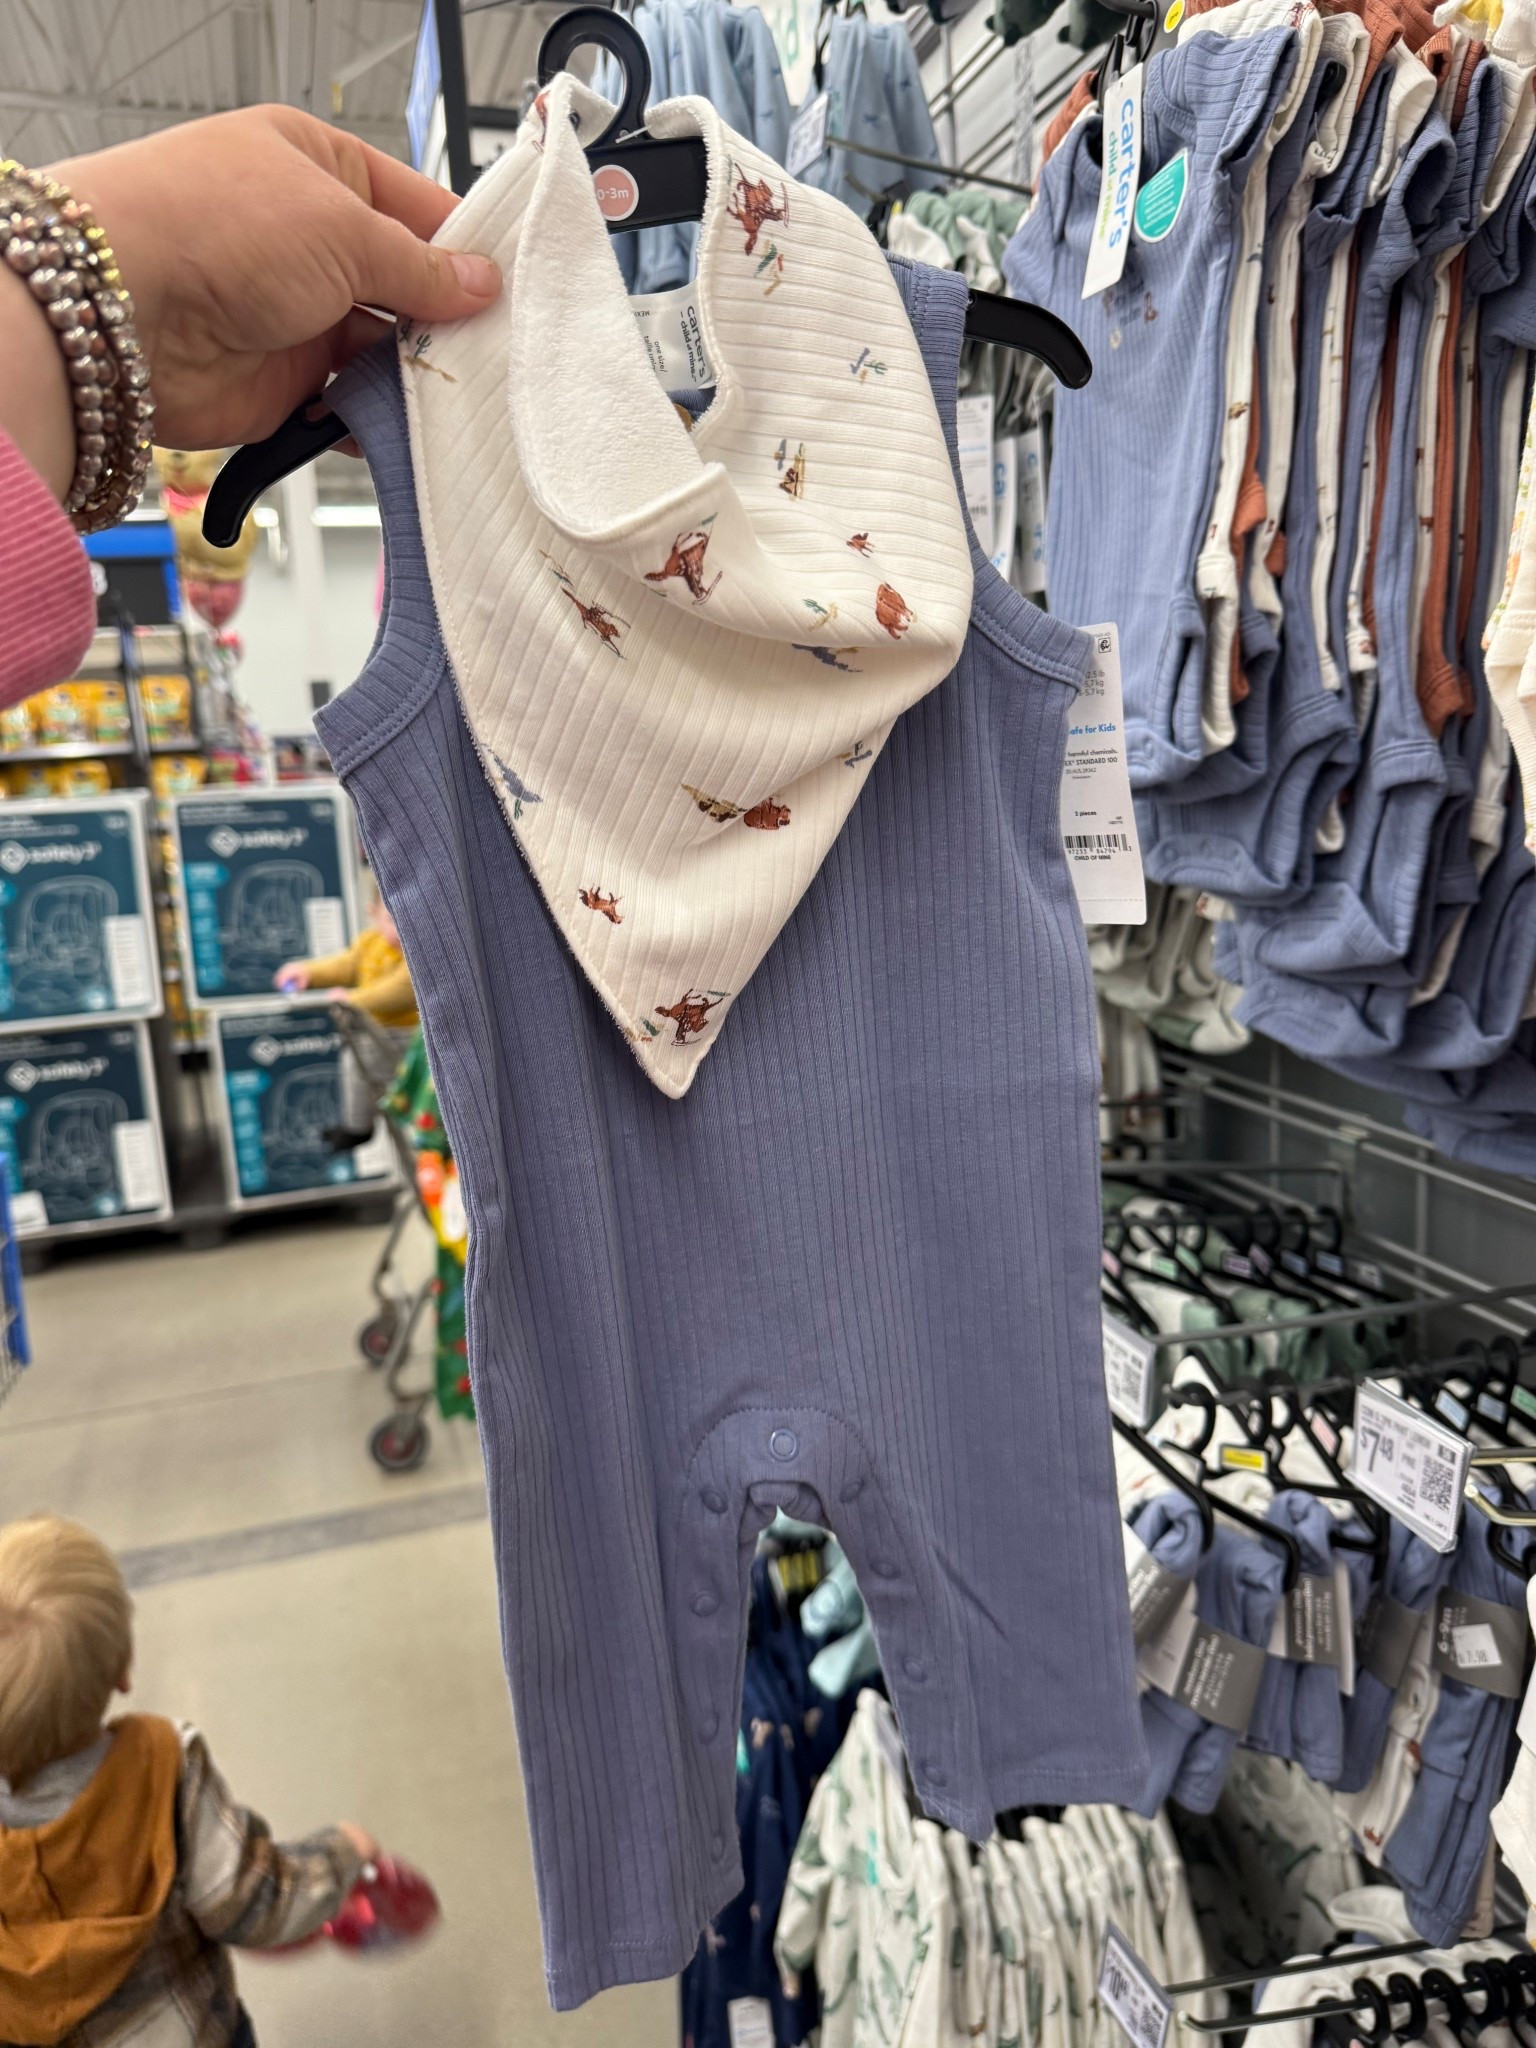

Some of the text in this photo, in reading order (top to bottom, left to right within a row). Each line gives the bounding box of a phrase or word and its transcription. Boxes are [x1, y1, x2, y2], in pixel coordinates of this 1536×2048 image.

[1108, 98, 1136, 249] carter's
[596, 187, 629, 201] 0-3m
[680, 320, 692, 343] child
[654, 341, 662, 354] one
[687, 305, 706, 378] carter's
[1069, 723, 1116, 735] afe for Kids
[1076, 757, 1106, 766] STANDARD
